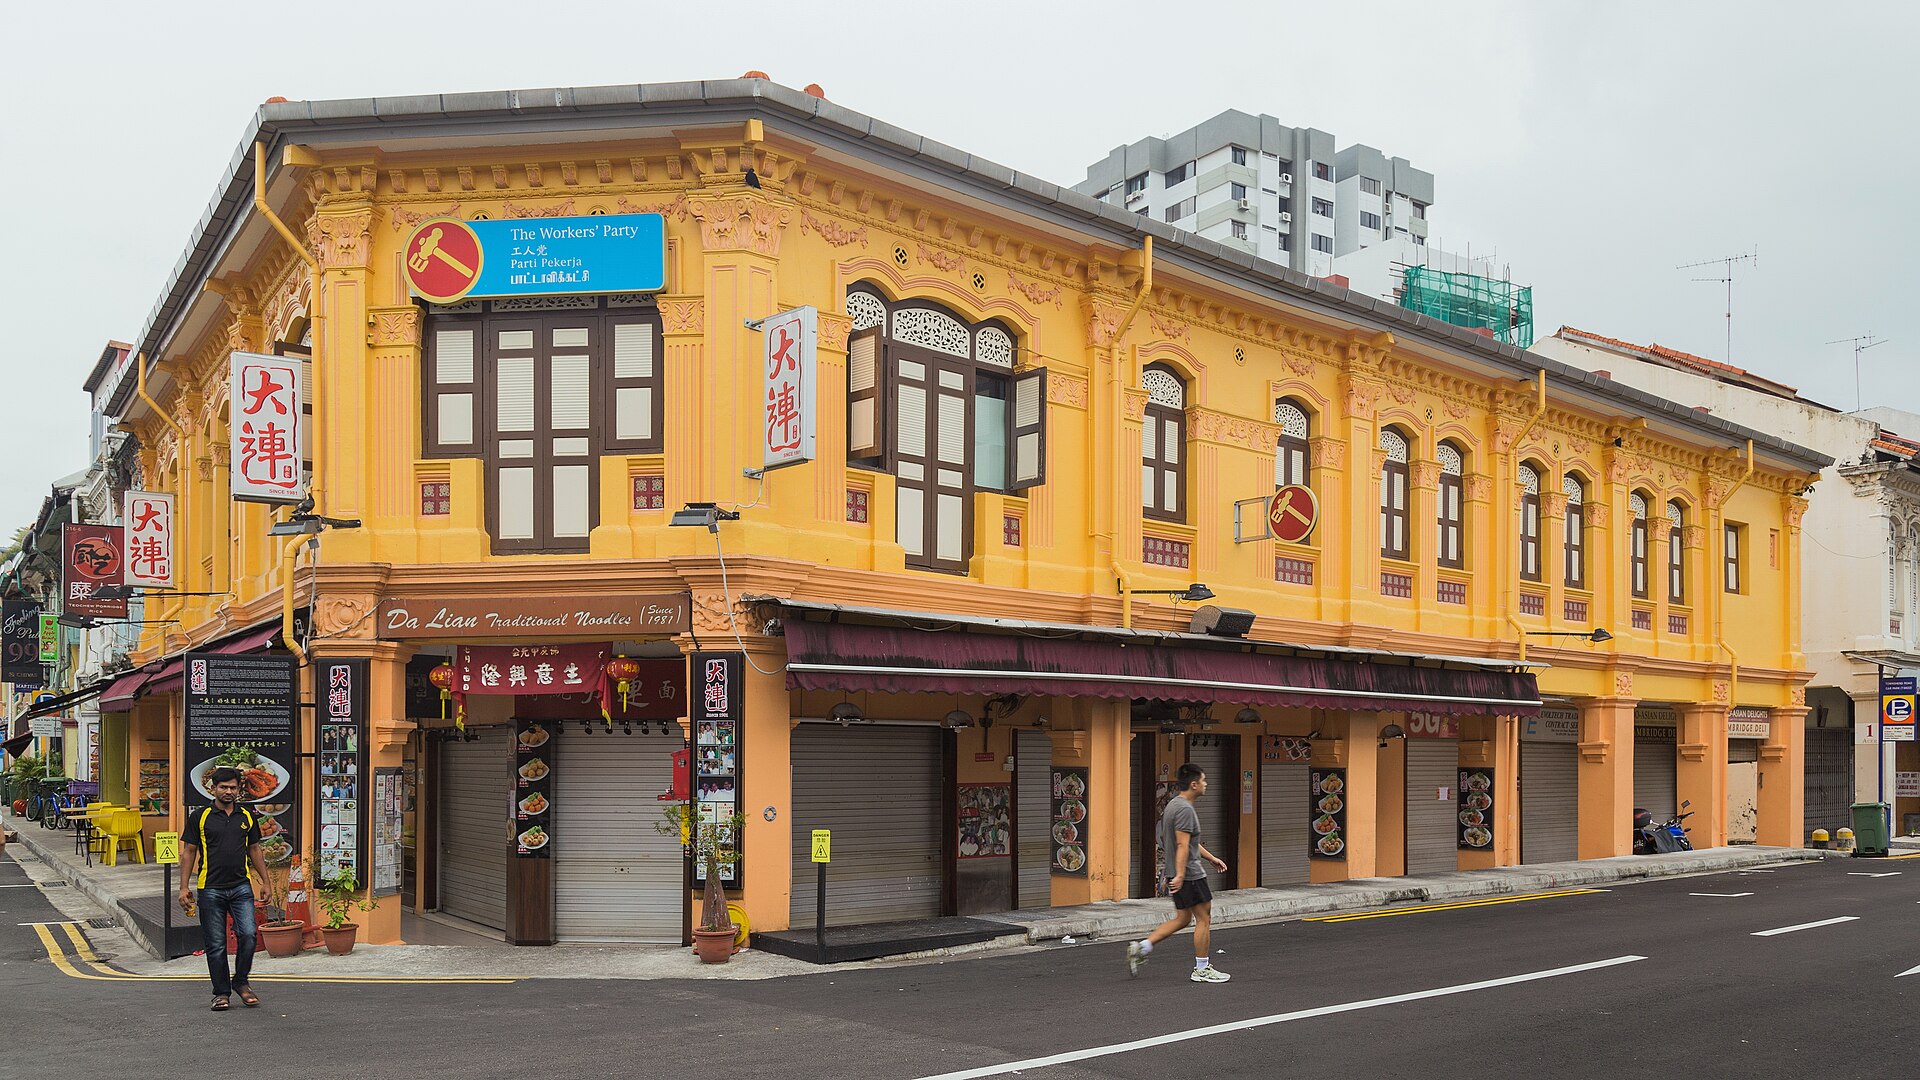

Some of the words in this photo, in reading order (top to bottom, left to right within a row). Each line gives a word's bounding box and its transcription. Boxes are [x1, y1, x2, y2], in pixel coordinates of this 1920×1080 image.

[510, 228, 536, 241] The
[603, 224, 639, 239] Party
[510, 244, 548, 256] 工人党
[510, 258, 538, 269] Parti
[541, 258, 583, 268] Pekerja
[767, 328, 799, 451] 大連
[239, 370, 294, 487] 大連
[130, 502, 168, 579] 大連
[386, 608, 420, 630] Da
[425, 607, 479, 629] Lian
[486, 612, 570, 628] Traditional
[573, 611, 633, 627] Noodles
[8, 642, 38, 664] 99
[329, 665, 352, 716] 大連
[704, 659, 728, 712] 大連
[1747, 710, 1768, 718] DELIGHTS
[1892, 700, 1909, 715] P
[1545, 720, 1569, 728] CONTRACT
[1755, 724, 1767, 732] DELI
[1866, 724, 1873, 737] 1
